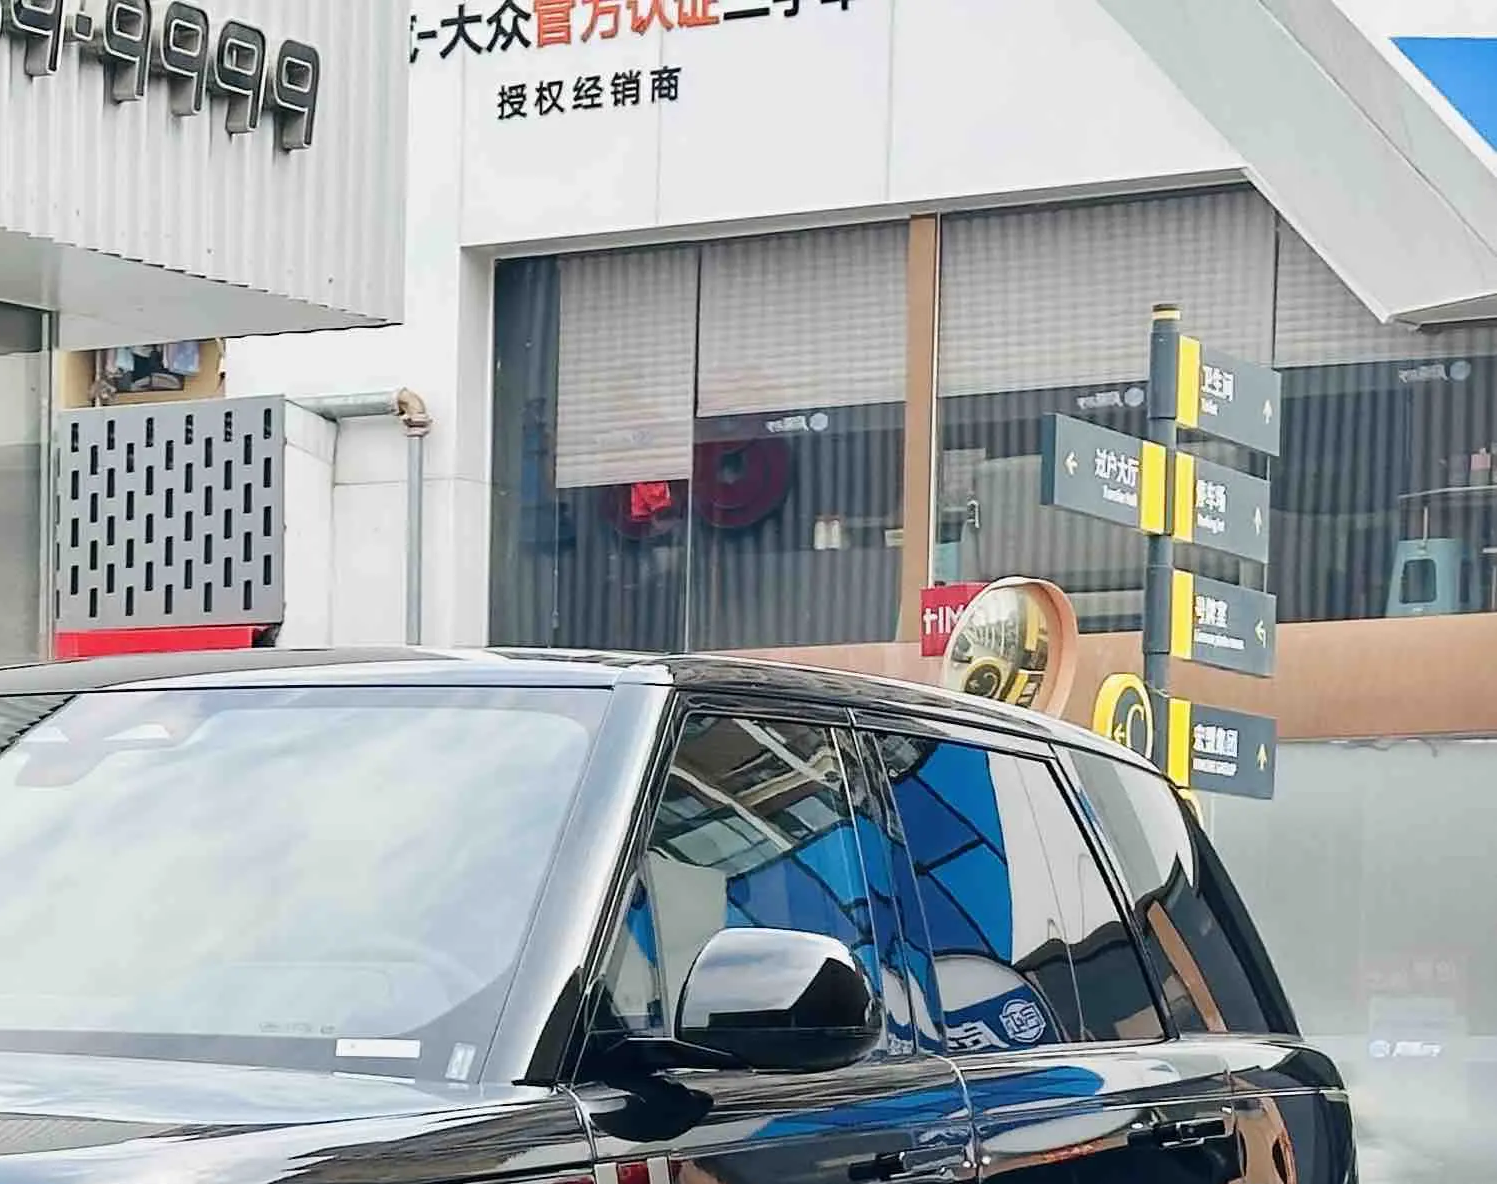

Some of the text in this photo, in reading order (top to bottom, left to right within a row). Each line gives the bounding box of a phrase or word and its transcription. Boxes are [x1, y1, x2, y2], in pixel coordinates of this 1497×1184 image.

[498, 66, 682, 120] 授权经销商
[1094, 448, 1139, 488] 过户大厅
